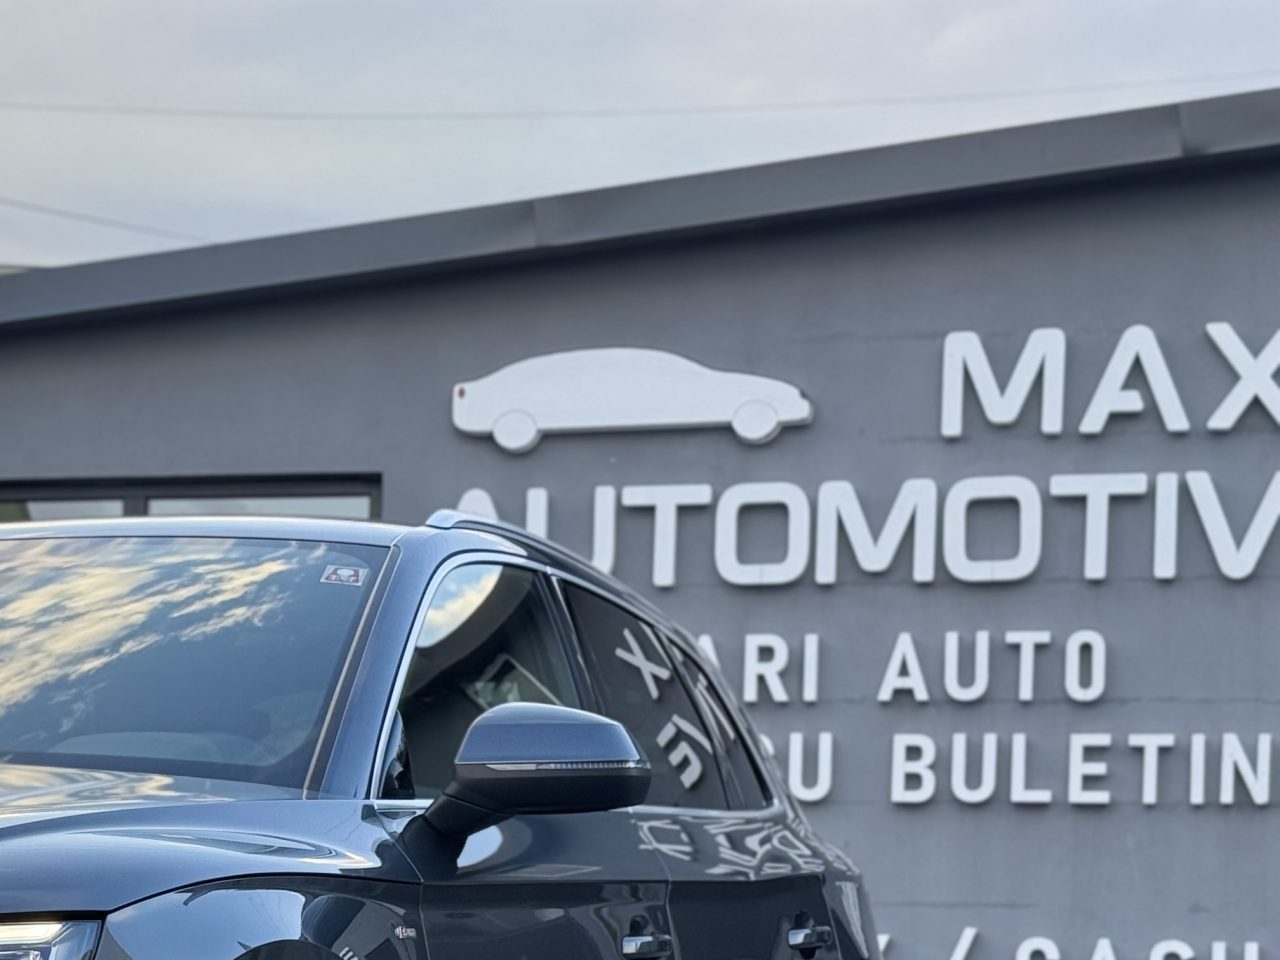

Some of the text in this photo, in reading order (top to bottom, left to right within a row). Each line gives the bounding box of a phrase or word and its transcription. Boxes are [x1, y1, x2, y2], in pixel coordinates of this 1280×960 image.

[940, 321, 1280, 438] MAX
[876, 629, 1108, 703] AUTO
[889, 731, 1273, 806] BULETIN
